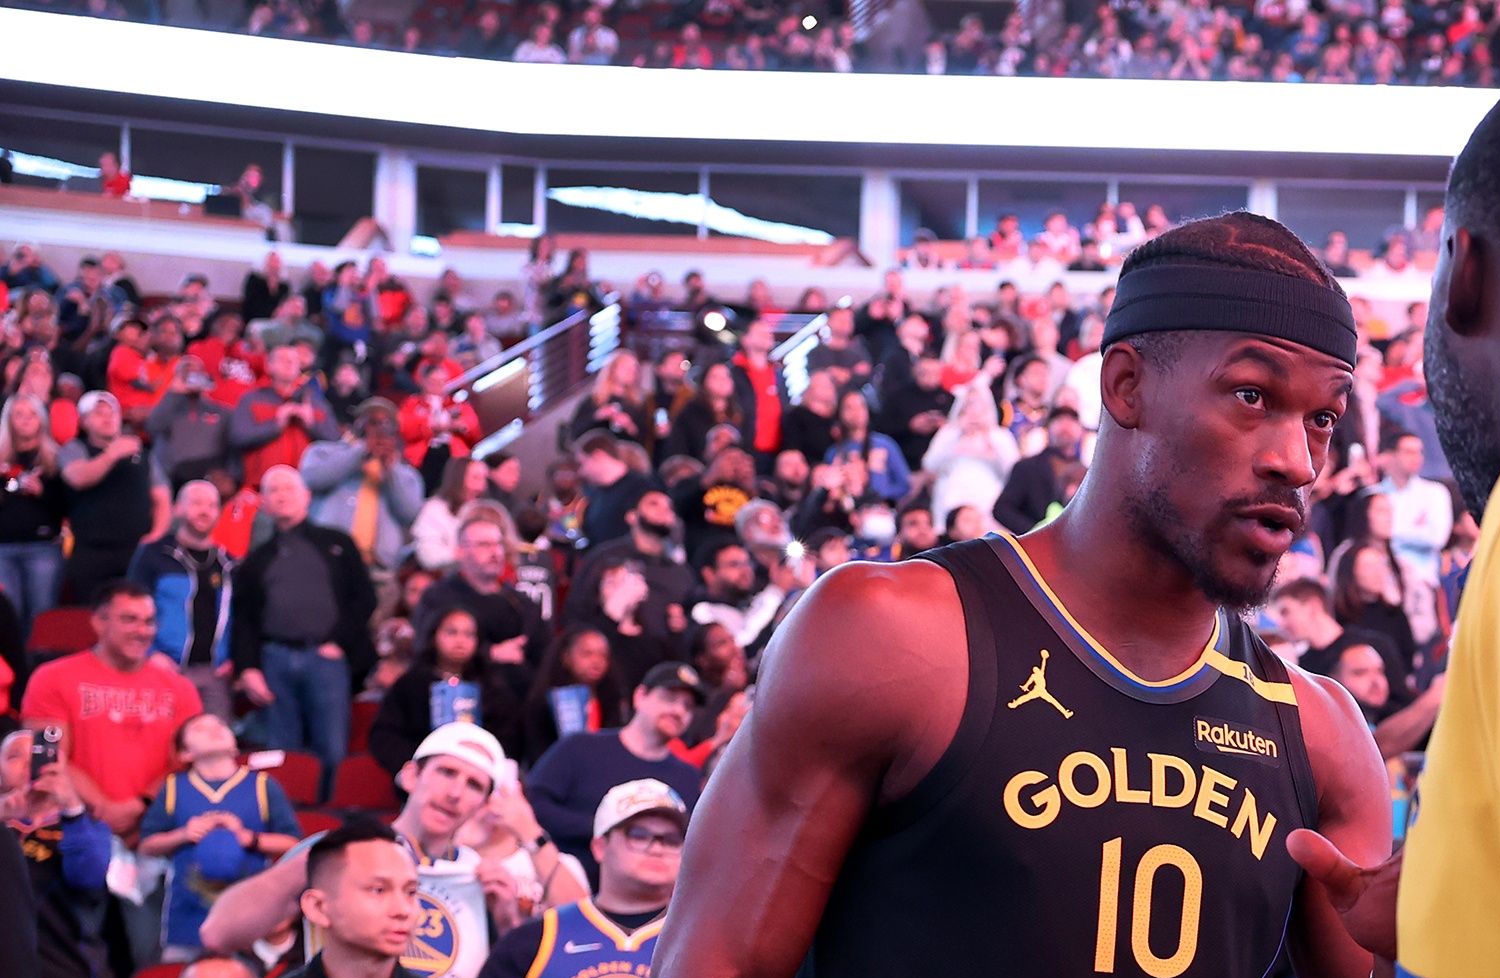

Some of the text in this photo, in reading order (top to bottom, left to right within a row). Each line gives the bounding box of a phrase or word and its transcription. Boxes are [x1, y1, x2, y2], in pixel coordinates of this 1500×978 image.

[1197, 720, 1278, 758] Rakuten
[1003, 747, 1276, 860] GOLDEN
[1094, 837, 1203, 978] 10
